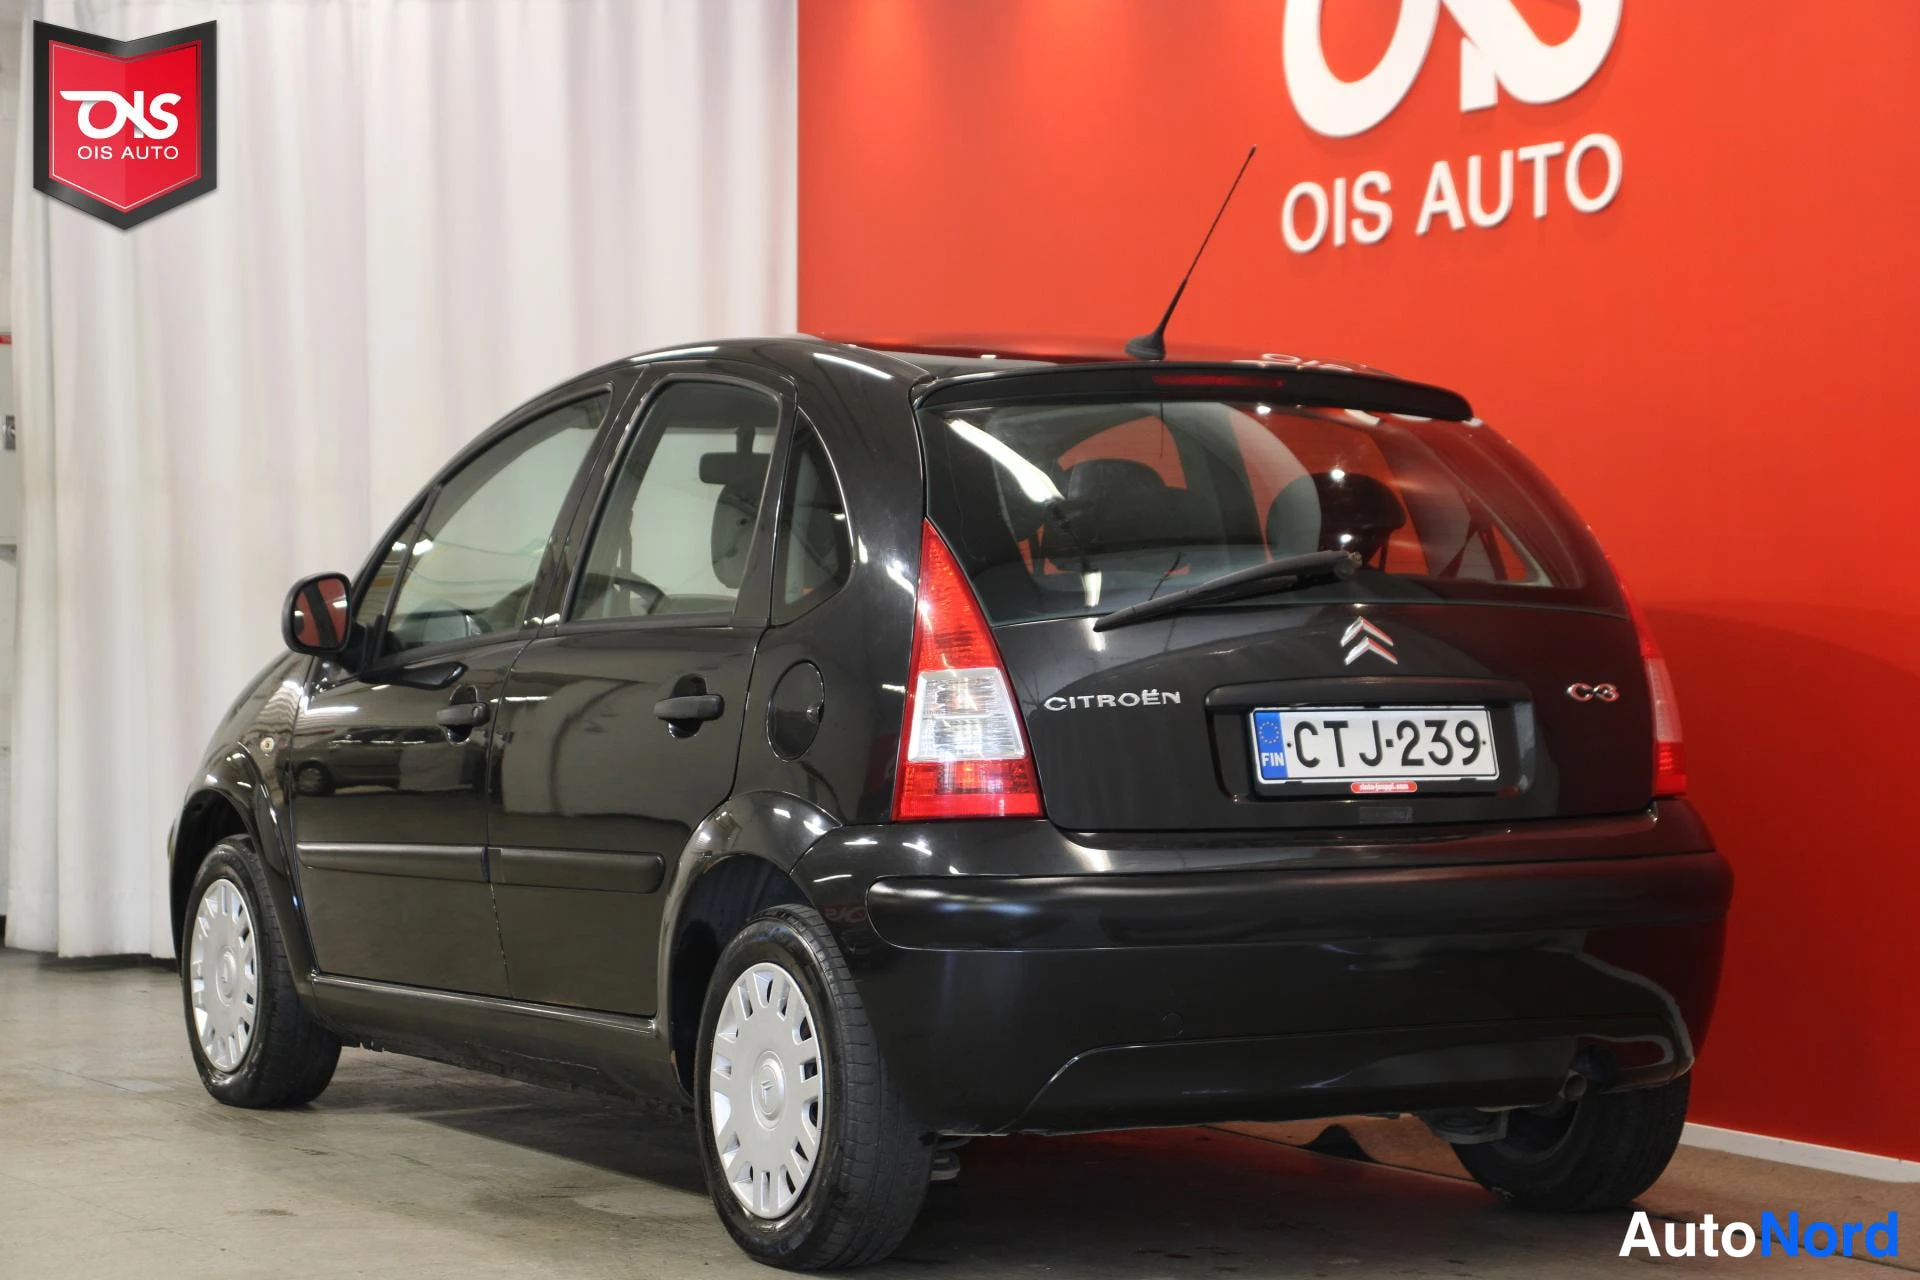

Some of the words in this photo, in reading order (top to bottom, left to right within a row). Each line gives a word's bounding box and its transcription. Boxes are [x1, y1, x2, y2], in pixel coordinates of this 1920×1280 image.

[1282, 170, 1393, 253] OIS
[1416, 133, 1622, 234] AUTO
[1043, 688, 1182, 711] CITROËN
[1566, 682, 1620, 702] C3
[1293, 719, 1482, 768] CTJ-239
[1261, 752, 1285, 767] FIN
